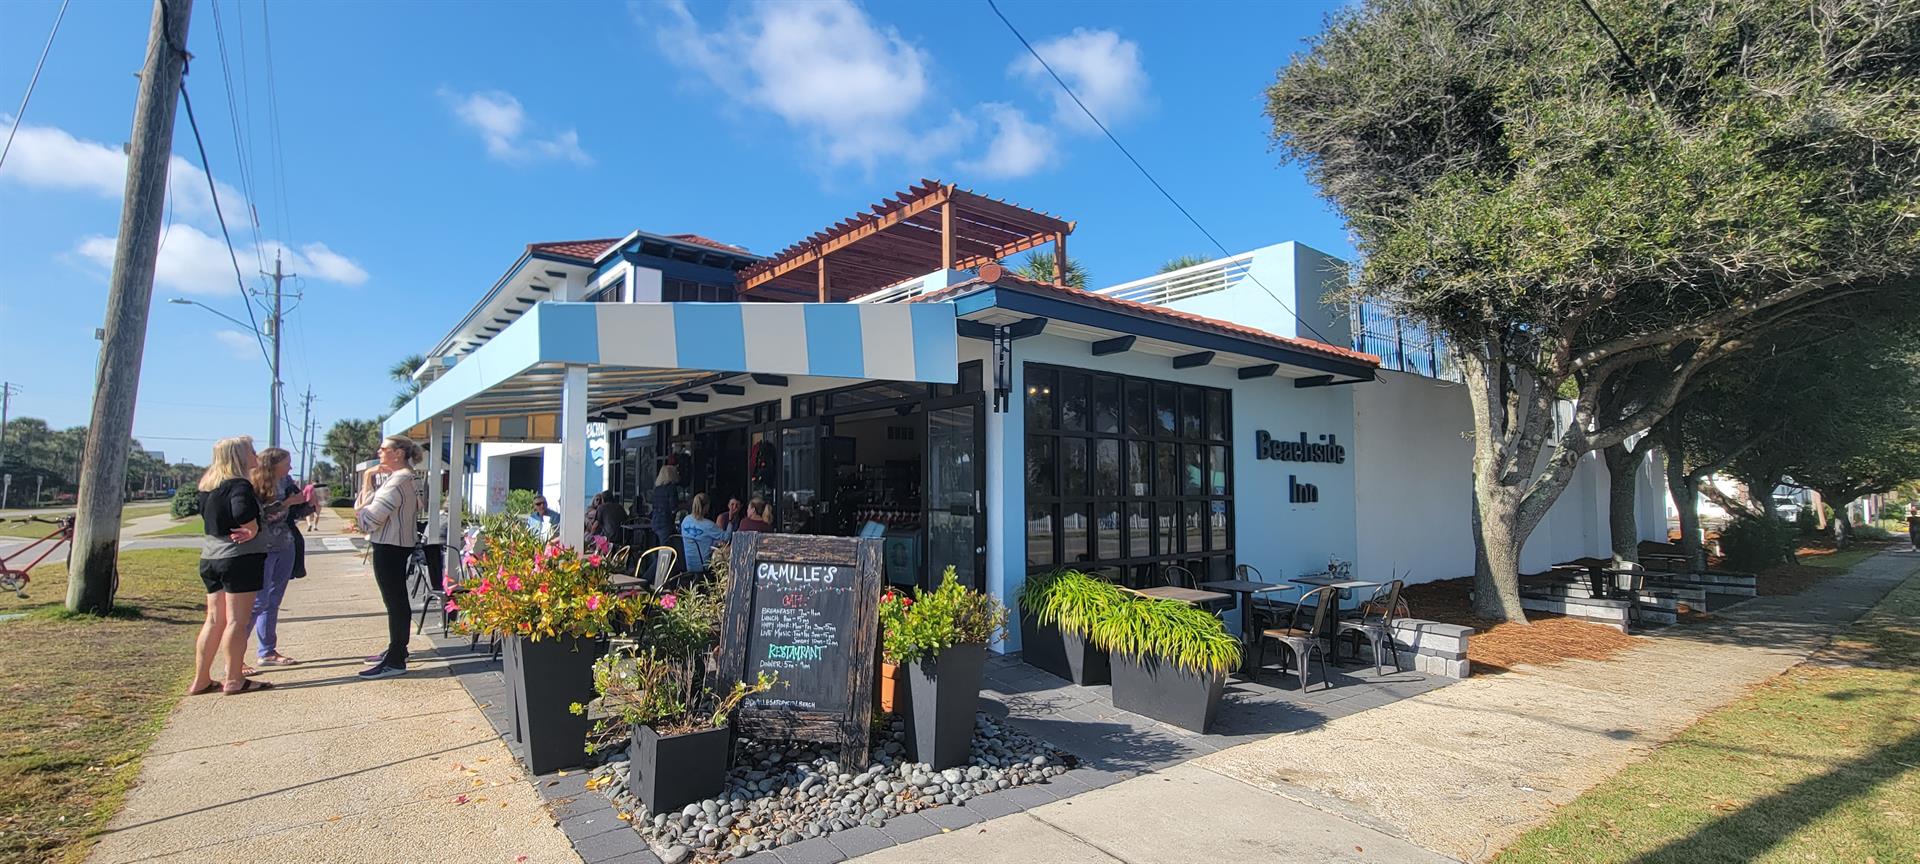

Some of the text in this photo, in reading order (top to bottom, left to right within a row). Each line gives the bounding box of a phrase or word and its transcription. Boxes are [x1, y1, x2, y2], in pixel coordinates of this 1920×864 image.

[1255, 429, 1345, 464] Beachside
[1288, 475, 1318, 503] Inn
[757, 563, 838, 583] CAMILLE'S
[768, 643, 827, 661] RESTAURANT
